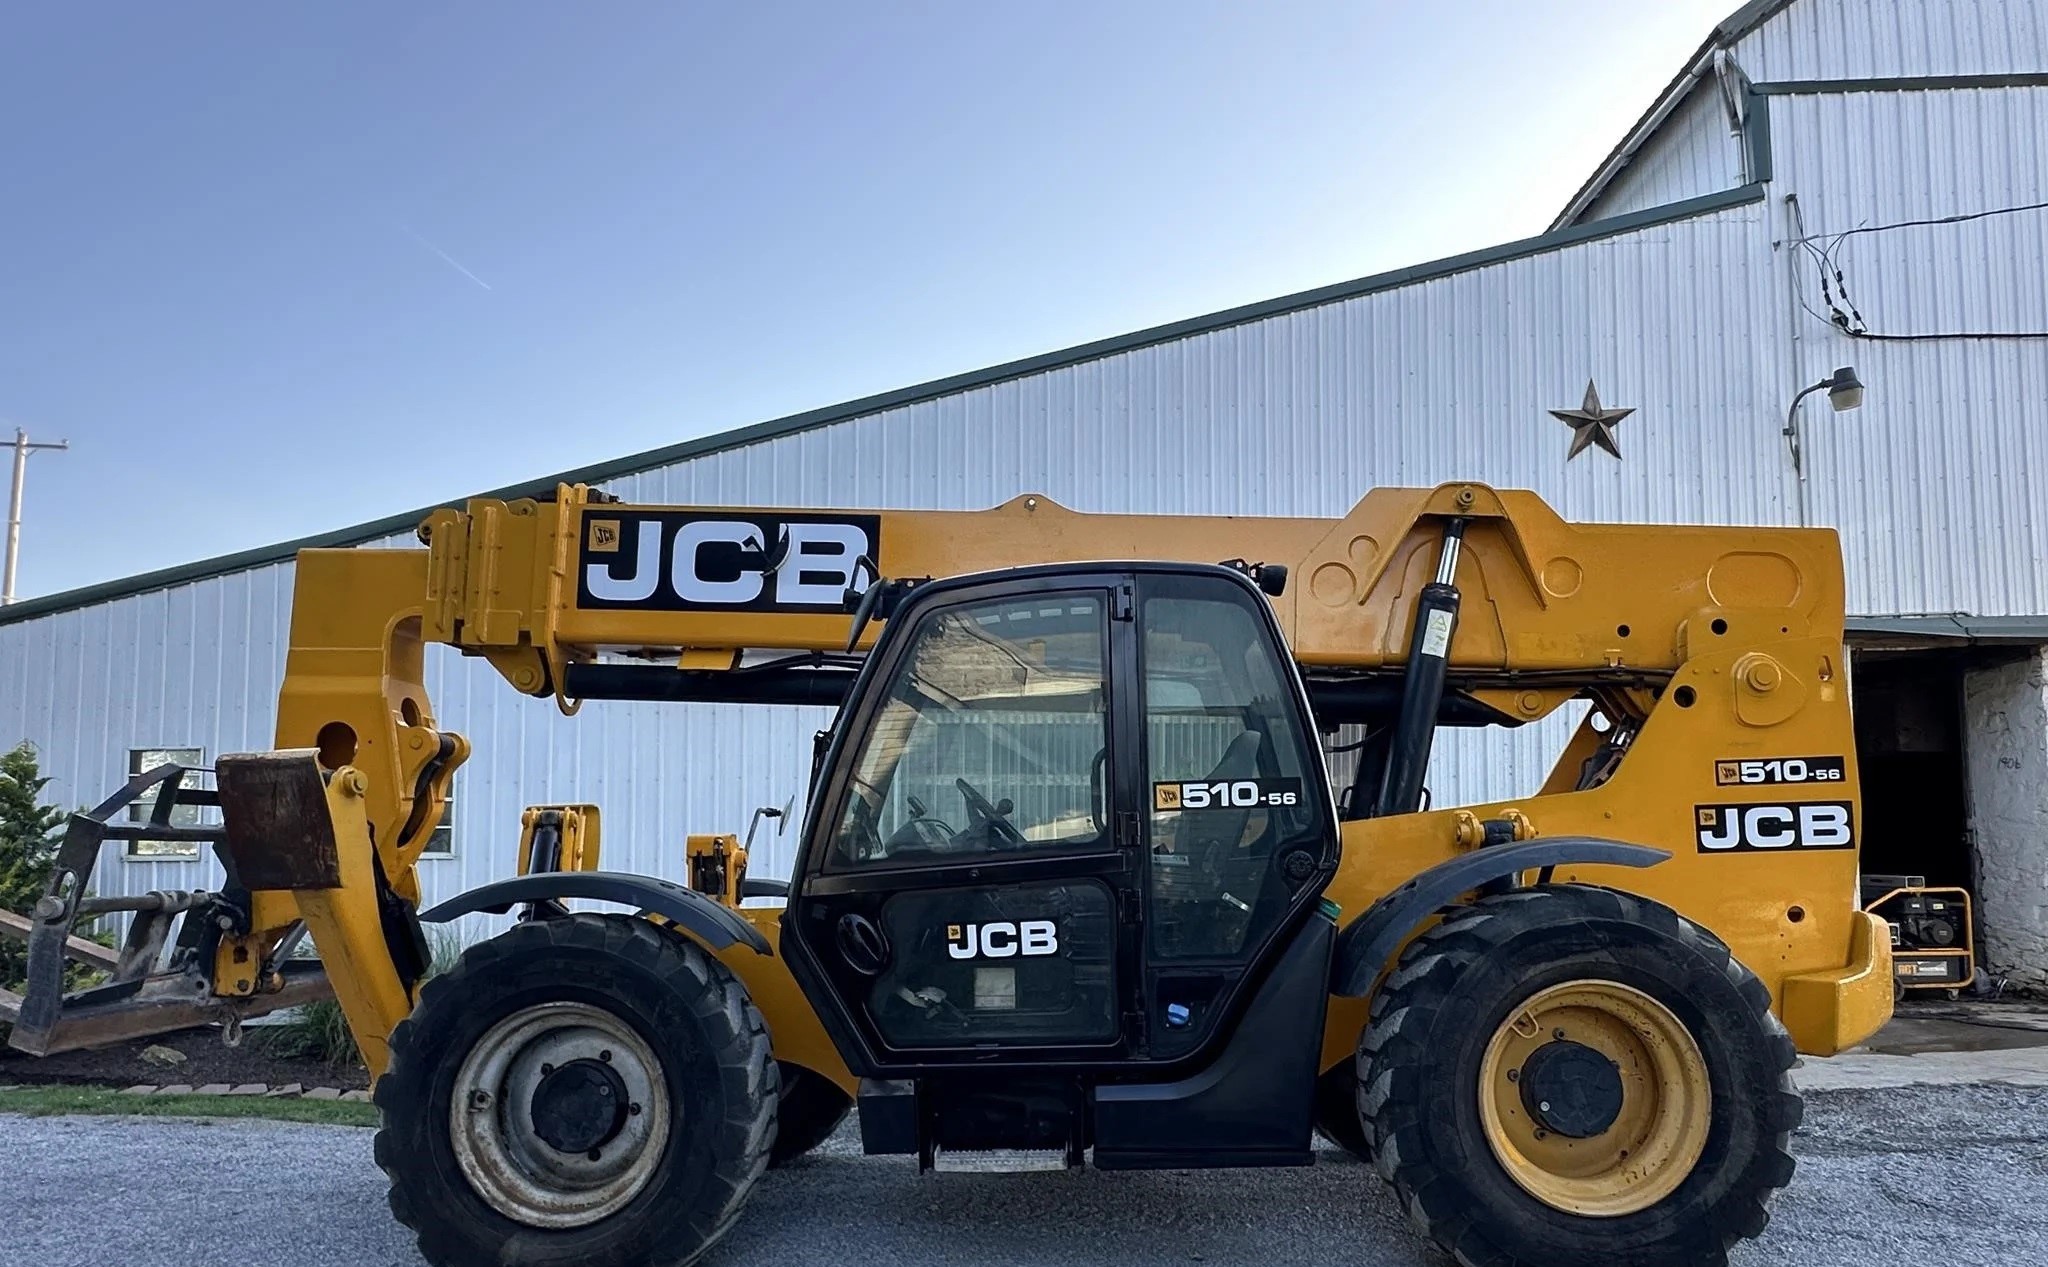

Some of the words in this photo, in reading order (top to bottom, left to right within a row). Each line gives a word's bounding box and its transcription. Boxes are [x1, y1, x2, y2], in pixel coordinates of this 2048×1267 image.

[594, 526, 616, 544] JCB
[586, 520, 869, 604] JCB
[1741, 760, 1840, 783] 510-56
[1183, 781, 1297, 808] 510-56
[1700, 805, 1850, 849] JCB
[948, 920, 1058, 959] JCB
